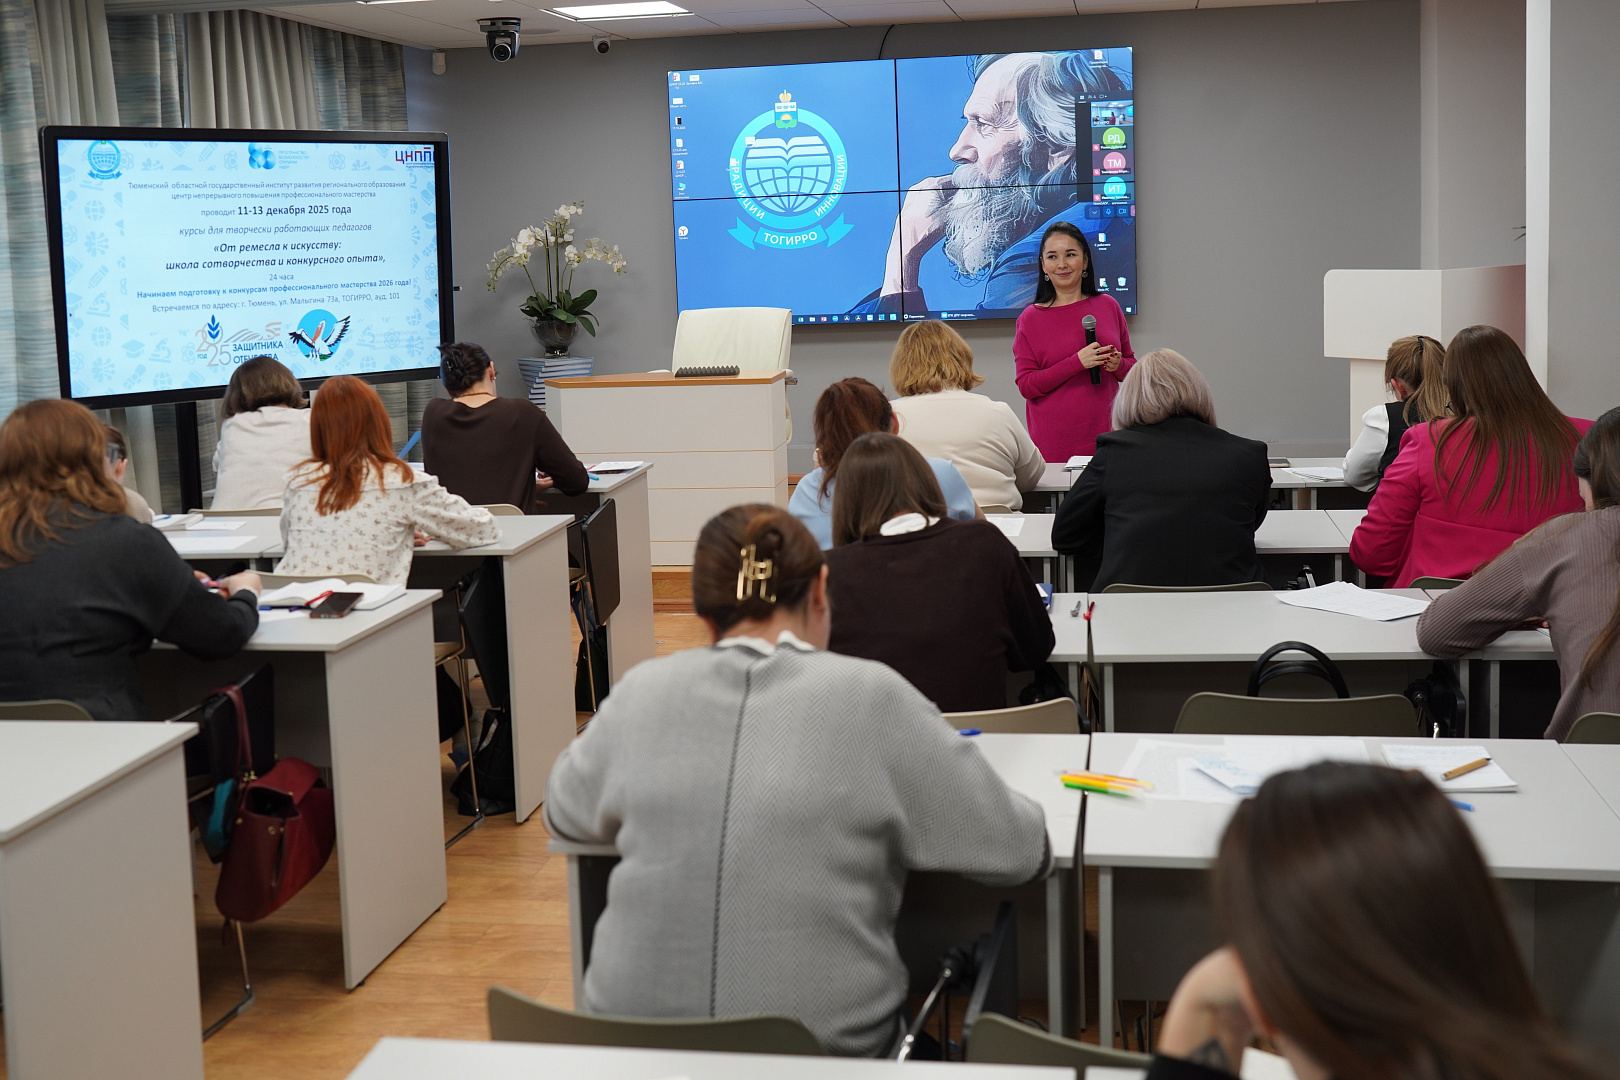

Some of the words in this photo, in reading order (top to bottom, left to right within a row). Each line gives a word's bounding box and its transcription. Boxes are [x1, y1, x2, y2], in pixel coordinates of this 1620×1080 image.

[1107, 134, 1121, 145] РД
[395, 147, 435, 165] ЦНПП
[1107, 159, 1122, 168] ТМ
[208, 182, 264, 190] государственный
[293, 182, 322, 190] развития
[322, 182, 368, 190] регионального
[368, 181, 406, 190] образования
[814, 154, 847, 217] ИННОВАЦИИ
[1108, 184, 1122, 193] ИТ
[192, 192, 241, 200] непрерывного
[242, 191, 280, 199] повышения
[281, 191, 342, 199] профессионального
[200, 209, 236, 218] проводит
[237, 206, 263, 216] 11-13
[266, 205, 305, 216] декабря
[308, 205, 329, 214] 2025
[331, 206, 352, 215] года
[179, 227, 206, 237] курсы
[207, 225, 224, 235] для
[225, 226, 272, 236] творчески
[274, 224, 329, 235] работающих
[332, 223, 372, 233] педагогов
[763, 231, 818, 246] ТОГИРРО
[213, 243, 236, 253] «От
[239, 243, 280, 253] ремесла
[282, 243, 288, 251] к
[290, 241, 342, 252] искусству:
[165, 261, 199, 270] школа
[202, 257, 276, 270] сотворчества
[278, 258, 284, 266] и
[286, 256, 344, 266] конкурсного
[346, 254, 386, 265] опыта»,
[269, 273, 277, 281] 24
[278, 273, 294, 281] часа
[136, 290, 177, 299] Начинаем
[178, 288, 221, 299] подготовку
[228, 286, 268, 297] конкурсам
[269, 282, 339, 294] профессионального
[340, 280, 377, 290] мастерства
[378, 279, 394, 287] 2026
[152, 303, 200, 313] Встречаемся
[201, 303, 211, 311] по
[212, 301, 240, 310] адресу:
[247, 298, 277, 308] Тюмень,
[278, 298, 288, 307] ул.
[290, 296, 325, 306] Малыгина
[341, 293, 373, 303] ТОГИРРО,
[374, 293, 388, 302] ауд.
[389, 292, 400, 301] 101
[232, 340, 284, 352] ЗАЩИТНИКА
